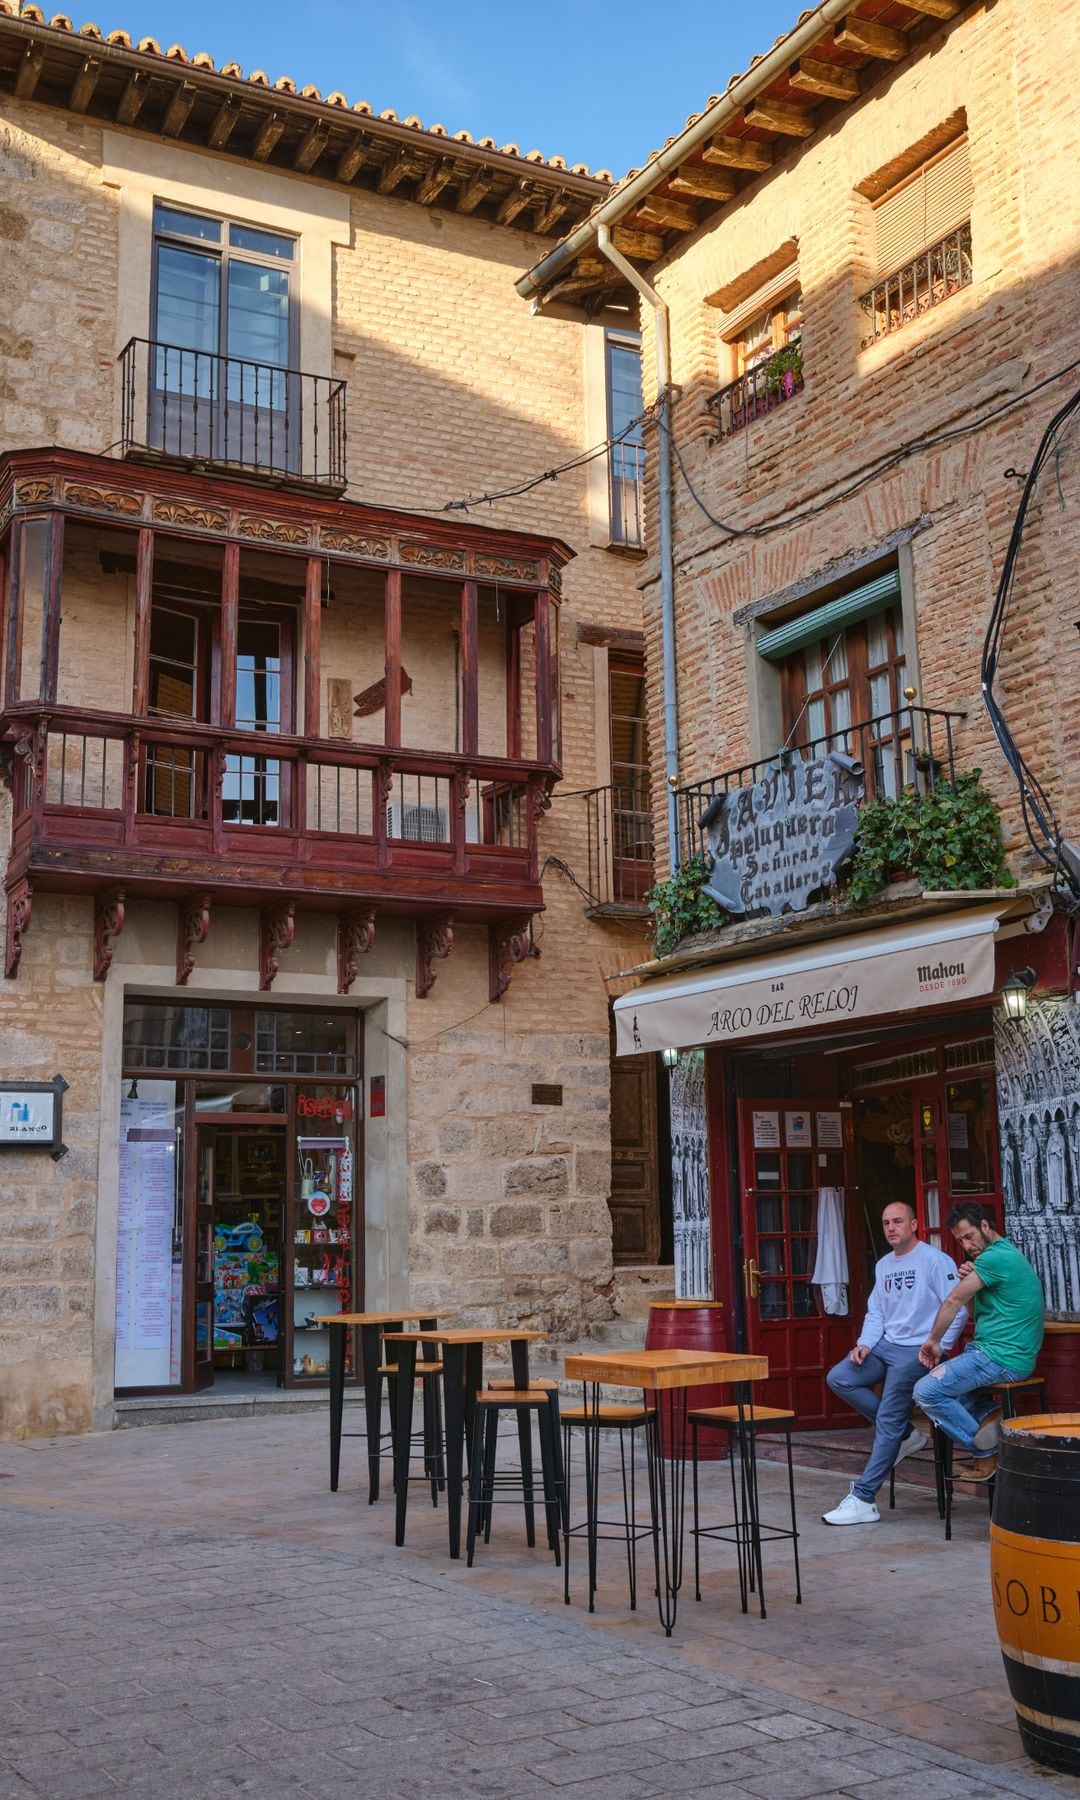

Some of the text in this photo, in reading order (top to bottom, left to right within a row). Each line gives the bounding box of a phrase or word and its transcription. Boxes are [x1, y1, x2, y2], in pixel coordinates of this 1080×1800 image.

[740, 861, 832, 905] Caballeros
[917, 962, 965, 982] Mahou
[771, 982, 785, 993] BAR
[920, 977, 967, 992] DESDE 1890
[707, 985, 859, 1036] ARCO DEL RELOJ
[9, 1124, 47, 1132] BLANCO
